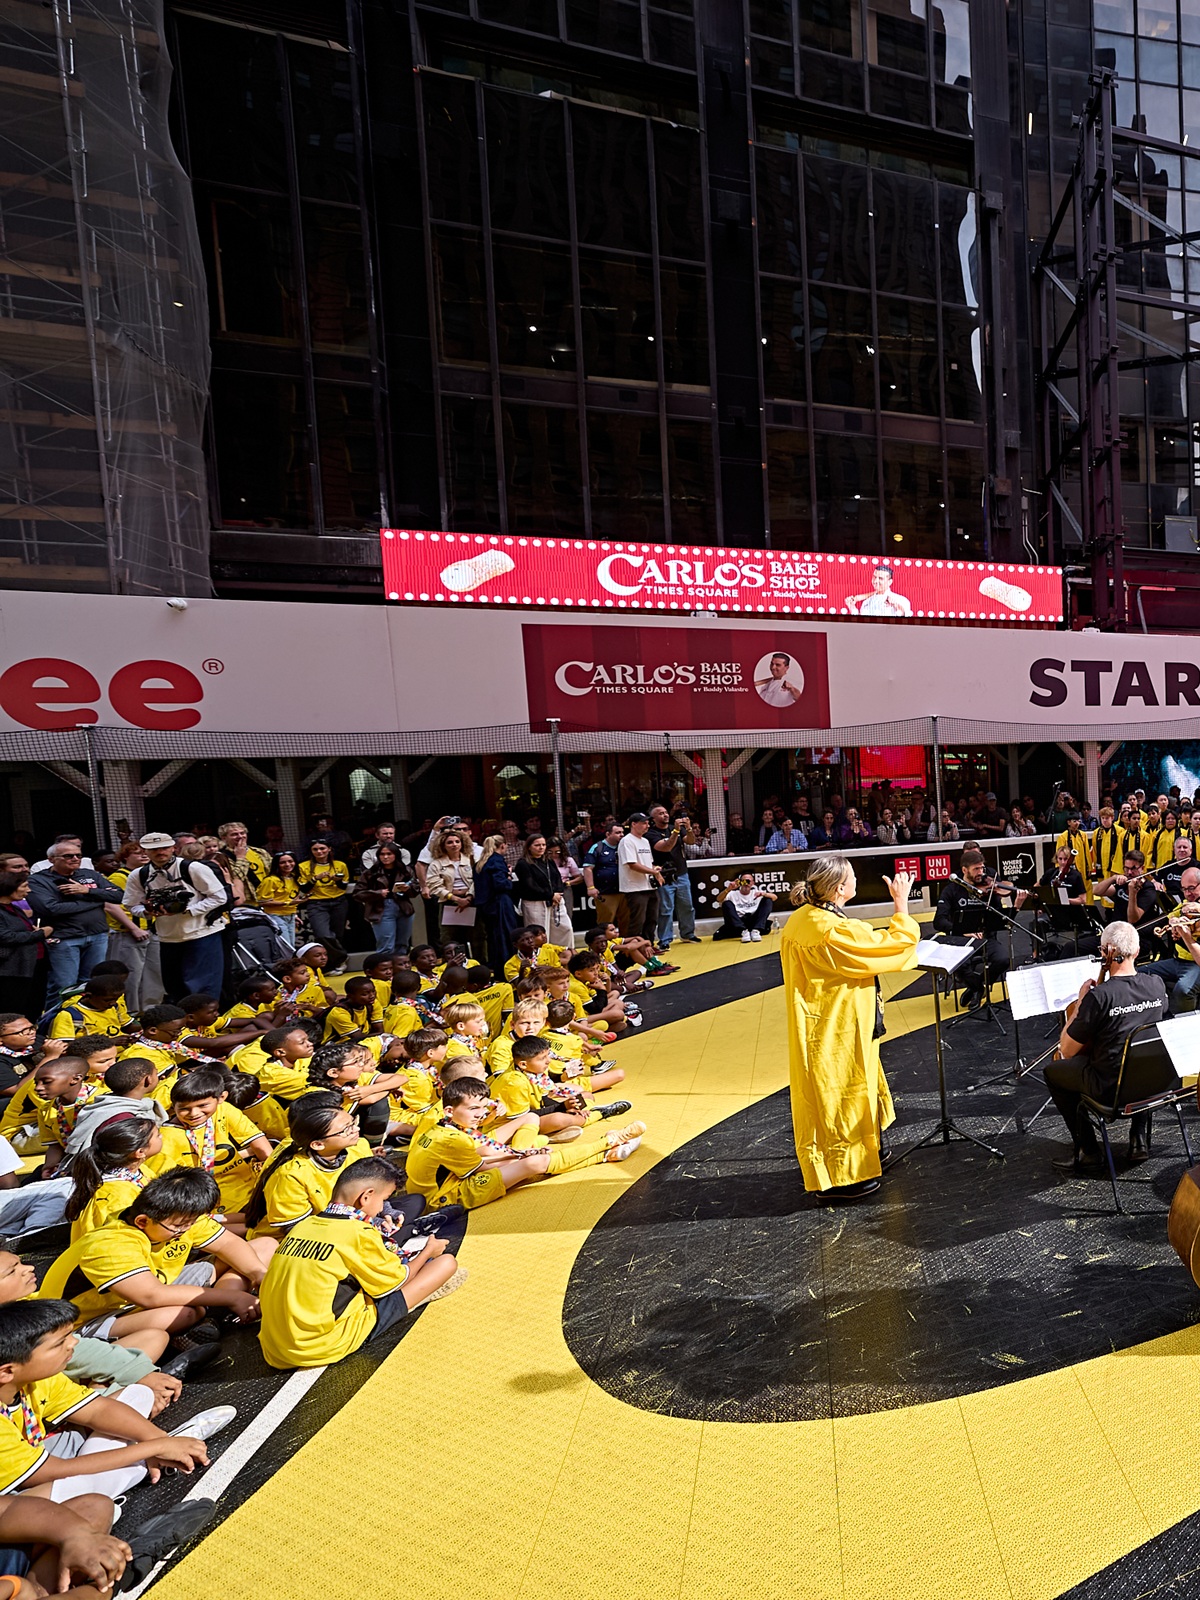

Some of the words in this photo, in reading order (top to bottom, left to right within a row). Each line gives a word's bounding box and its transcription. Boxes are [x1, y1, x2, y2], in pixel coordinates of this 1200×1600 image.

[597, 553, 766, 596] CARLO'S
[769, 561, 819, 576] BAKE
[769, 576, 821, 590] SHOP
[644, 585, 684, 595] TIMES
[687, 587, 739, 598] SQUARE
[700, 662, 742, 674] BAKE
[555, 661, 697, 696] CARLO'S
[700, 674, 743, 685] SHOP
[594, 686, 627, 694] TIMES
[631, 687, 674, 695] SQUARE
[928, 858, 946, 867] UNI
[928, 867, 948, 878] QLO
[165, 1244, 187, 1258] BVB
